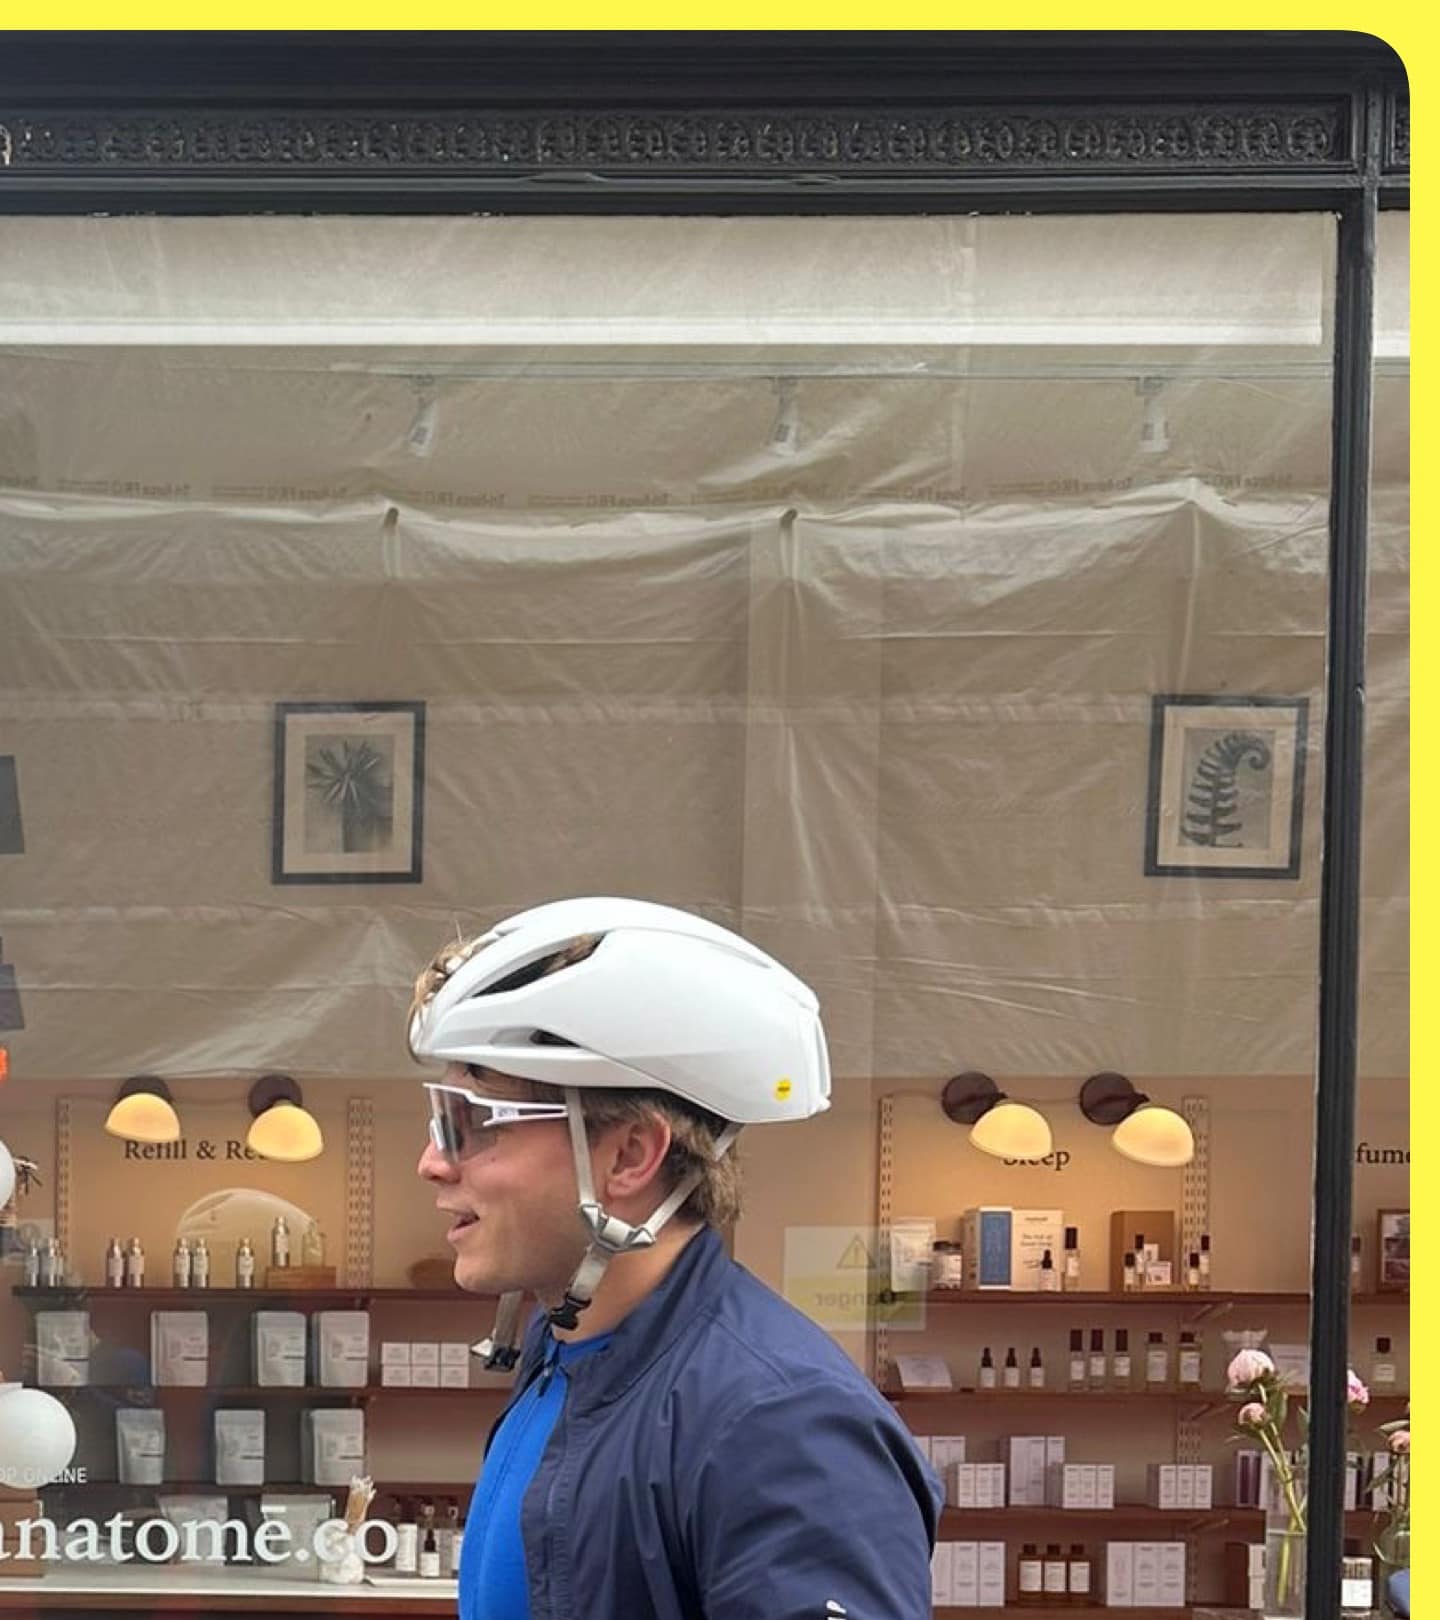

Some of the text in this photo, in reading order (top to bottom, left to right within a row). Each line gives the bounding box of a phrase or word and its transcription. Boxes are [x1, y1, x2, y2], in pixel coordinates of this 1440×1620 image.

[196, 1141, 216, 1160] &
[226, 1141, 268, 1160] Re
[24, 1467, 88, 1484] ONLINE
